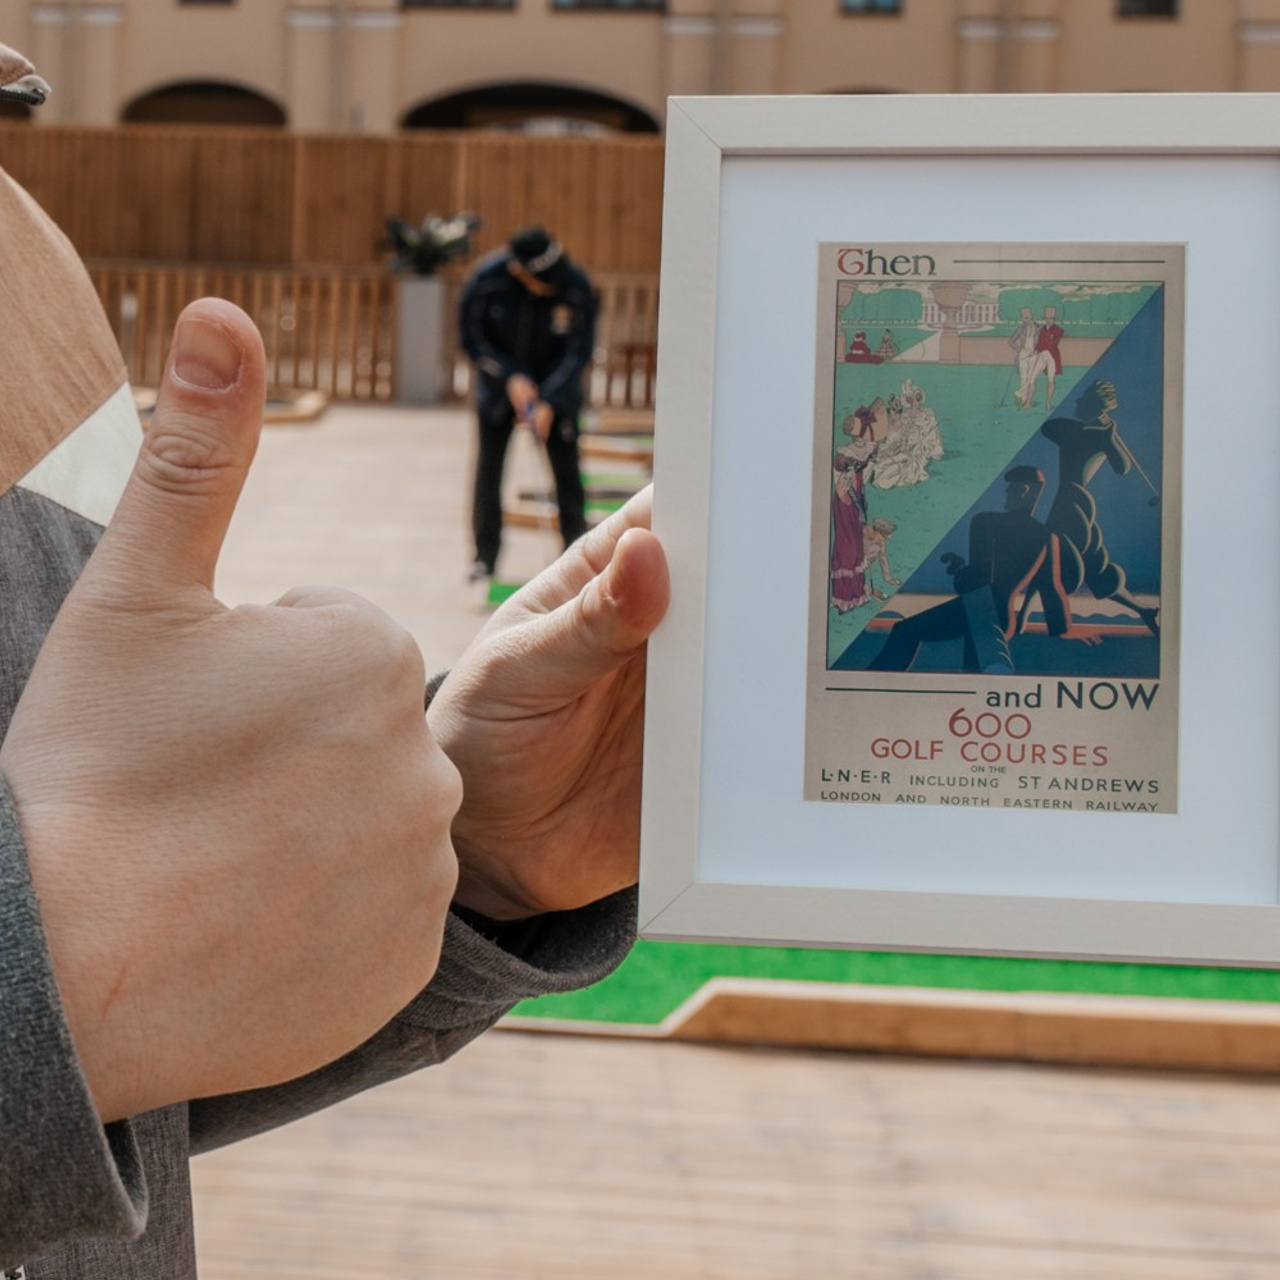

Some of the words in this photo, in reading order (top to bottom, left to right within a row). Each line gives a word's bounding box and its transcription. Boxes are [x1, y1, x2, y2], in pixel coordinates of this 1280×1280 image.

[837, 248, 937, 276] Then
[986, 683, 1042, 708] and
[1057, 681, 1160, 711] NOW
[948, 707, 1032, 739] 600
[871, 738, 944, 760] GOLF
[960, 741, 1108, 767] COURSES
[970, 765, 985, 773] ON
[989, 766, 1007, 774] THE
[909, 775, 999, 789] INCLUDING
[1018, 776, 1041, 789] ST
[1048, 777, 1159, 794] ANDREWS
[821, 791, 881, 802] LONDON
[895, 794, 927, 804] AND
[940, 796, 990, 807] NORTH
[1003, 798, 1073, 809] EASTERN
[1086, 801, 1159, 812] RAILWAY
